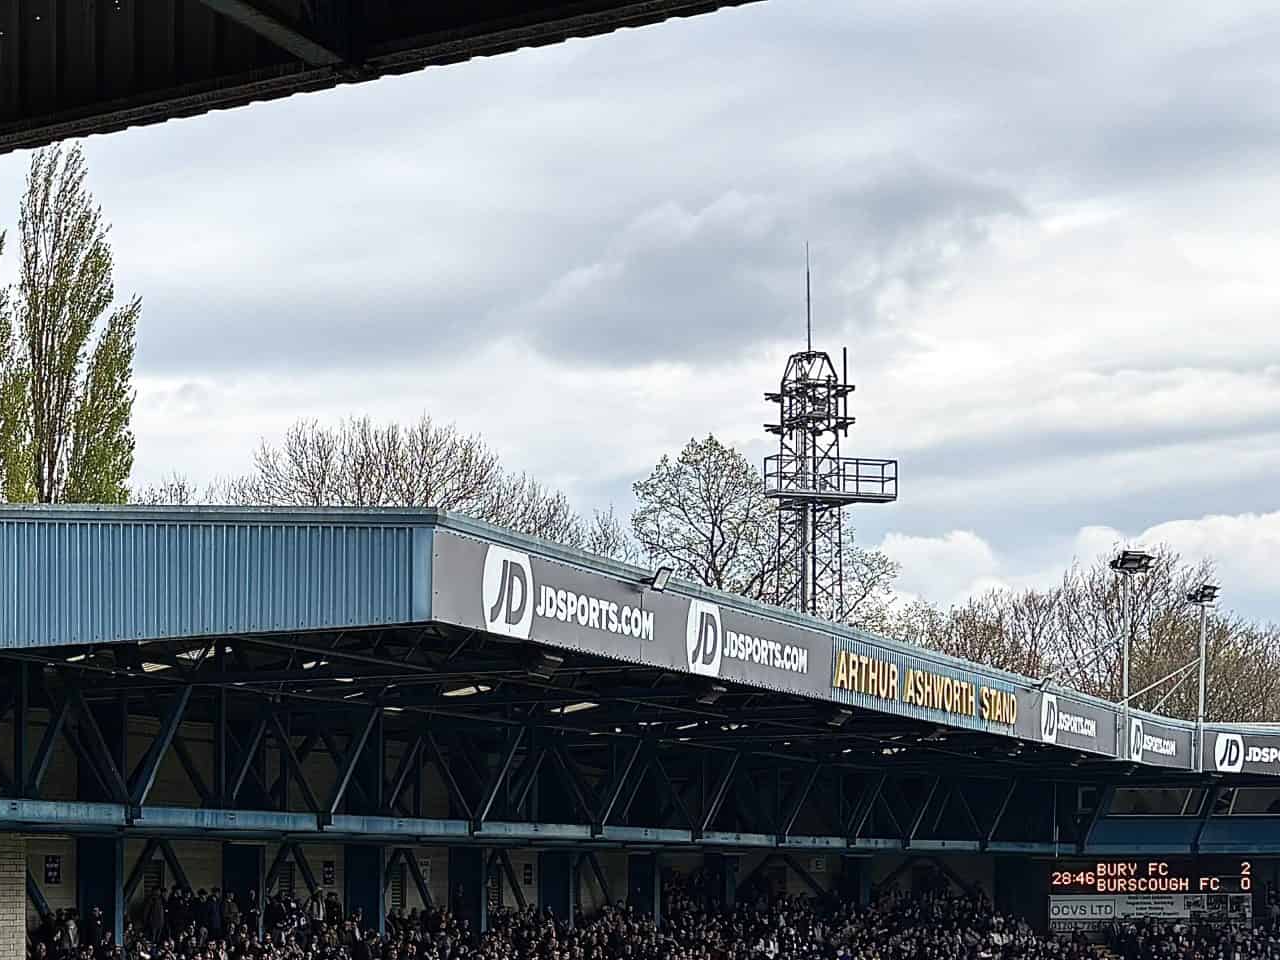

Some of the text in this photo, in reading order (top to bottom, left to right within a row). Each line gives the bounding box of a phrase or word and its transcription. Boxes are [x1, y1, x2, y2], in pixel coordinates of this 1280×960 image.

[536, 584, 654, 640] JDSPORTS.COM
[723, 631, 808, 674] JDSPORTS.COM
[833, 650, 1017, 724] ARTHUR ASHWORTH STAND
[1058, 711, 1097, 738] JDSPORTS.COM
[1051, 871, 1095, 885] 28:46
[1096, 862, 1251, 876] BURY FC 2
[1096, 878, 1189, 892] BURSCOUGH
[1199, 878, 1220, 891] FC
[1051, 904, 1087, 916] OCVS
[1090, 904, 1113, 916] LTD
